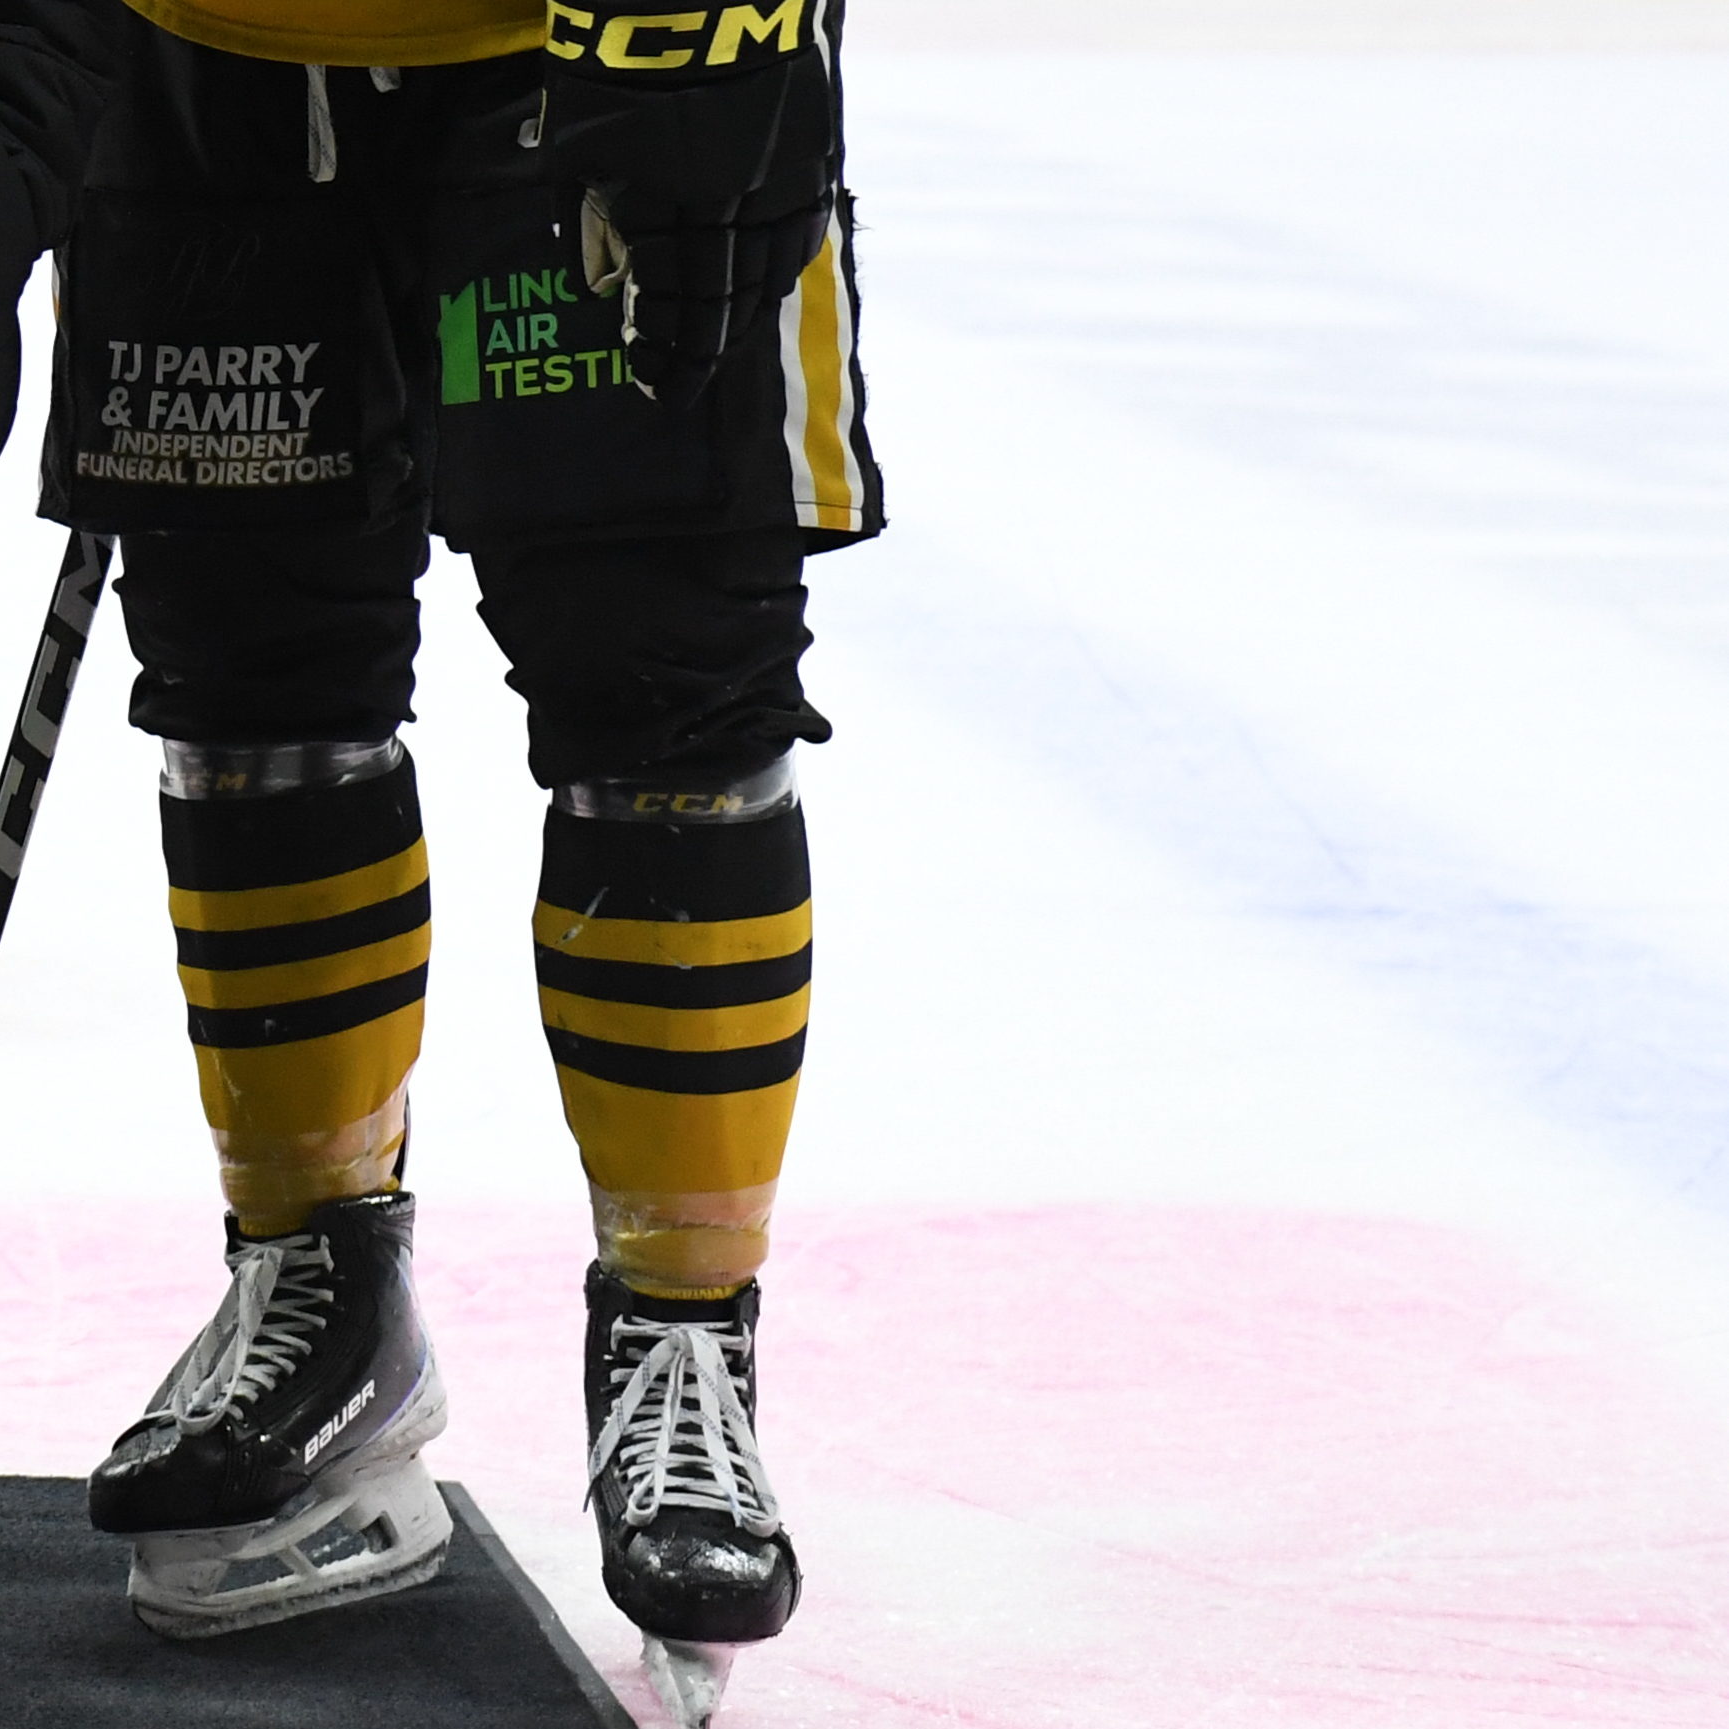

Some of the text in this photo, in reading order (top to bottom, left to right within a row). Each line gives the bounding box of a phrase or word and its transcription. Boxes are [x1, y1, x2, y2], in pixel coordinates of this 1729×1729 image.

[482, 268, 617, 313] LINC
[485, 312, 559, 357] AIR
[108, 340, 321, 386] TJ PARRY
[485, 349, 634, 400] TESTI
[101, 386, 325, 431] & FAMILY
[112, 430, 309, 459] INDEPENDENT
[77, 453, 354, 485] FUNERAL DIRECTORS
[631, 791, 744, 815] CCM
